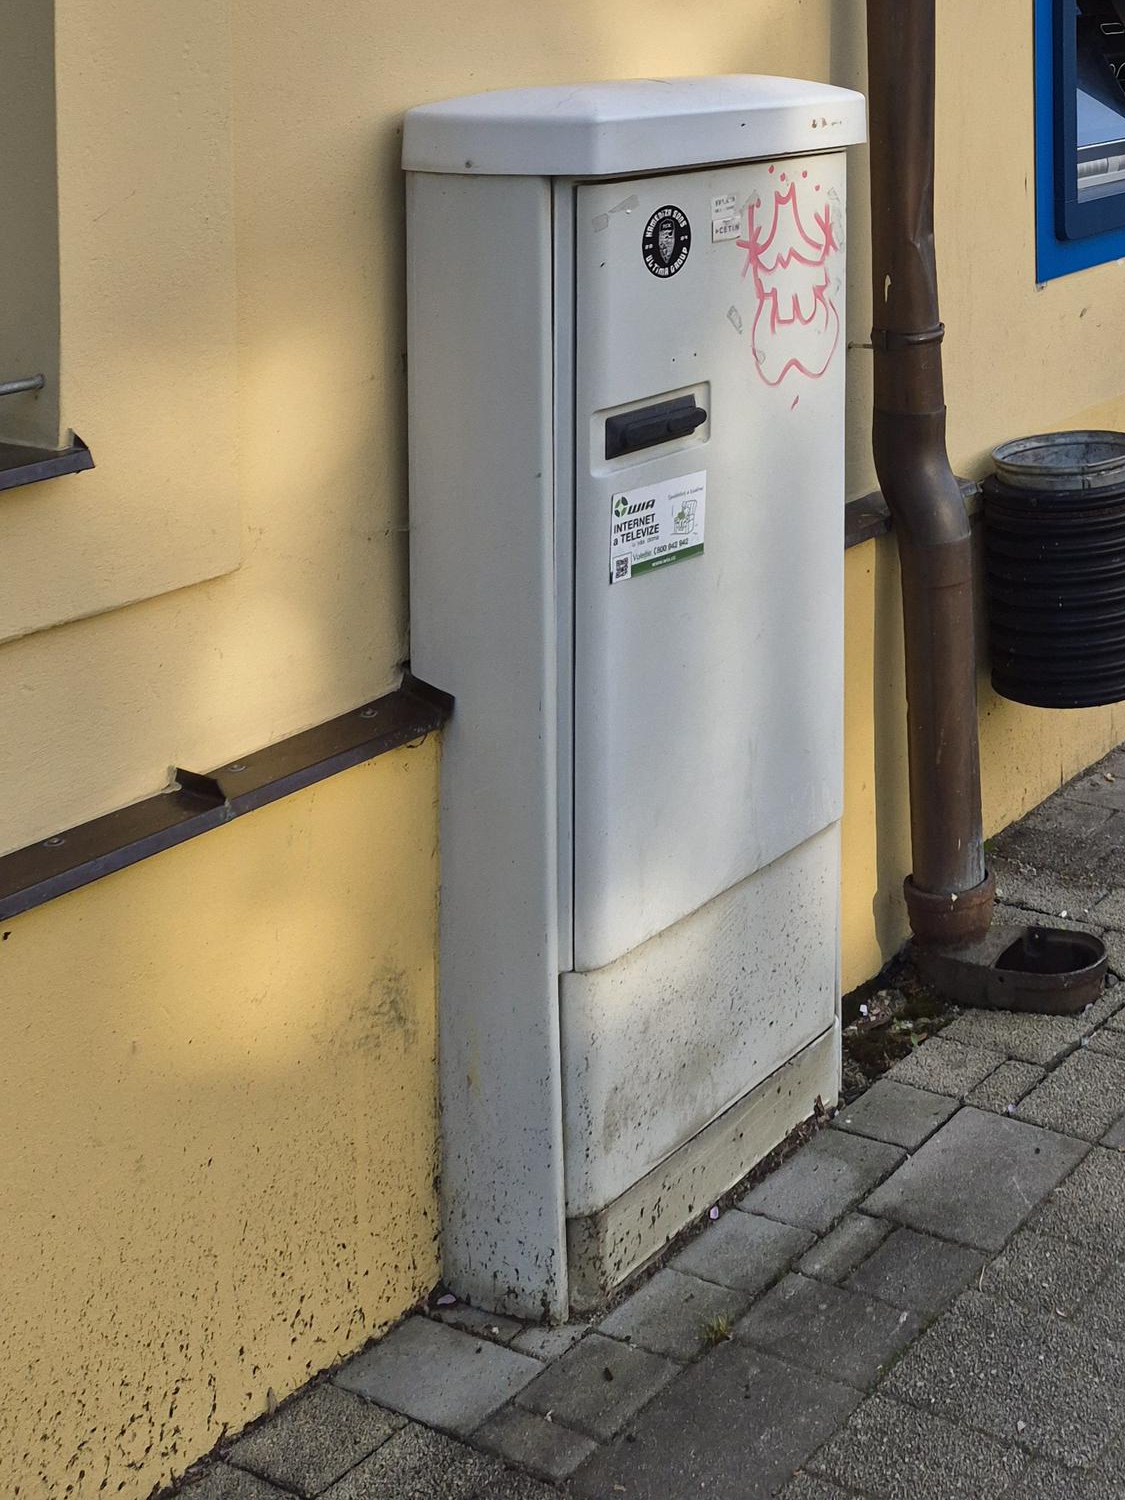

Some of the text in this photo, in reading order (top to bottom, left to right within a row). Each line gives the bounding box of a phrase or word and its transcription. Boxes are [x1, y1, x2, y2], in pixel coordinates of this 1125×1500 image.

[627, 498, 656, 515] WIA
[613, 513, 656, 534] INTERNET
[620, 523, 660, 544] TELEVIZE
